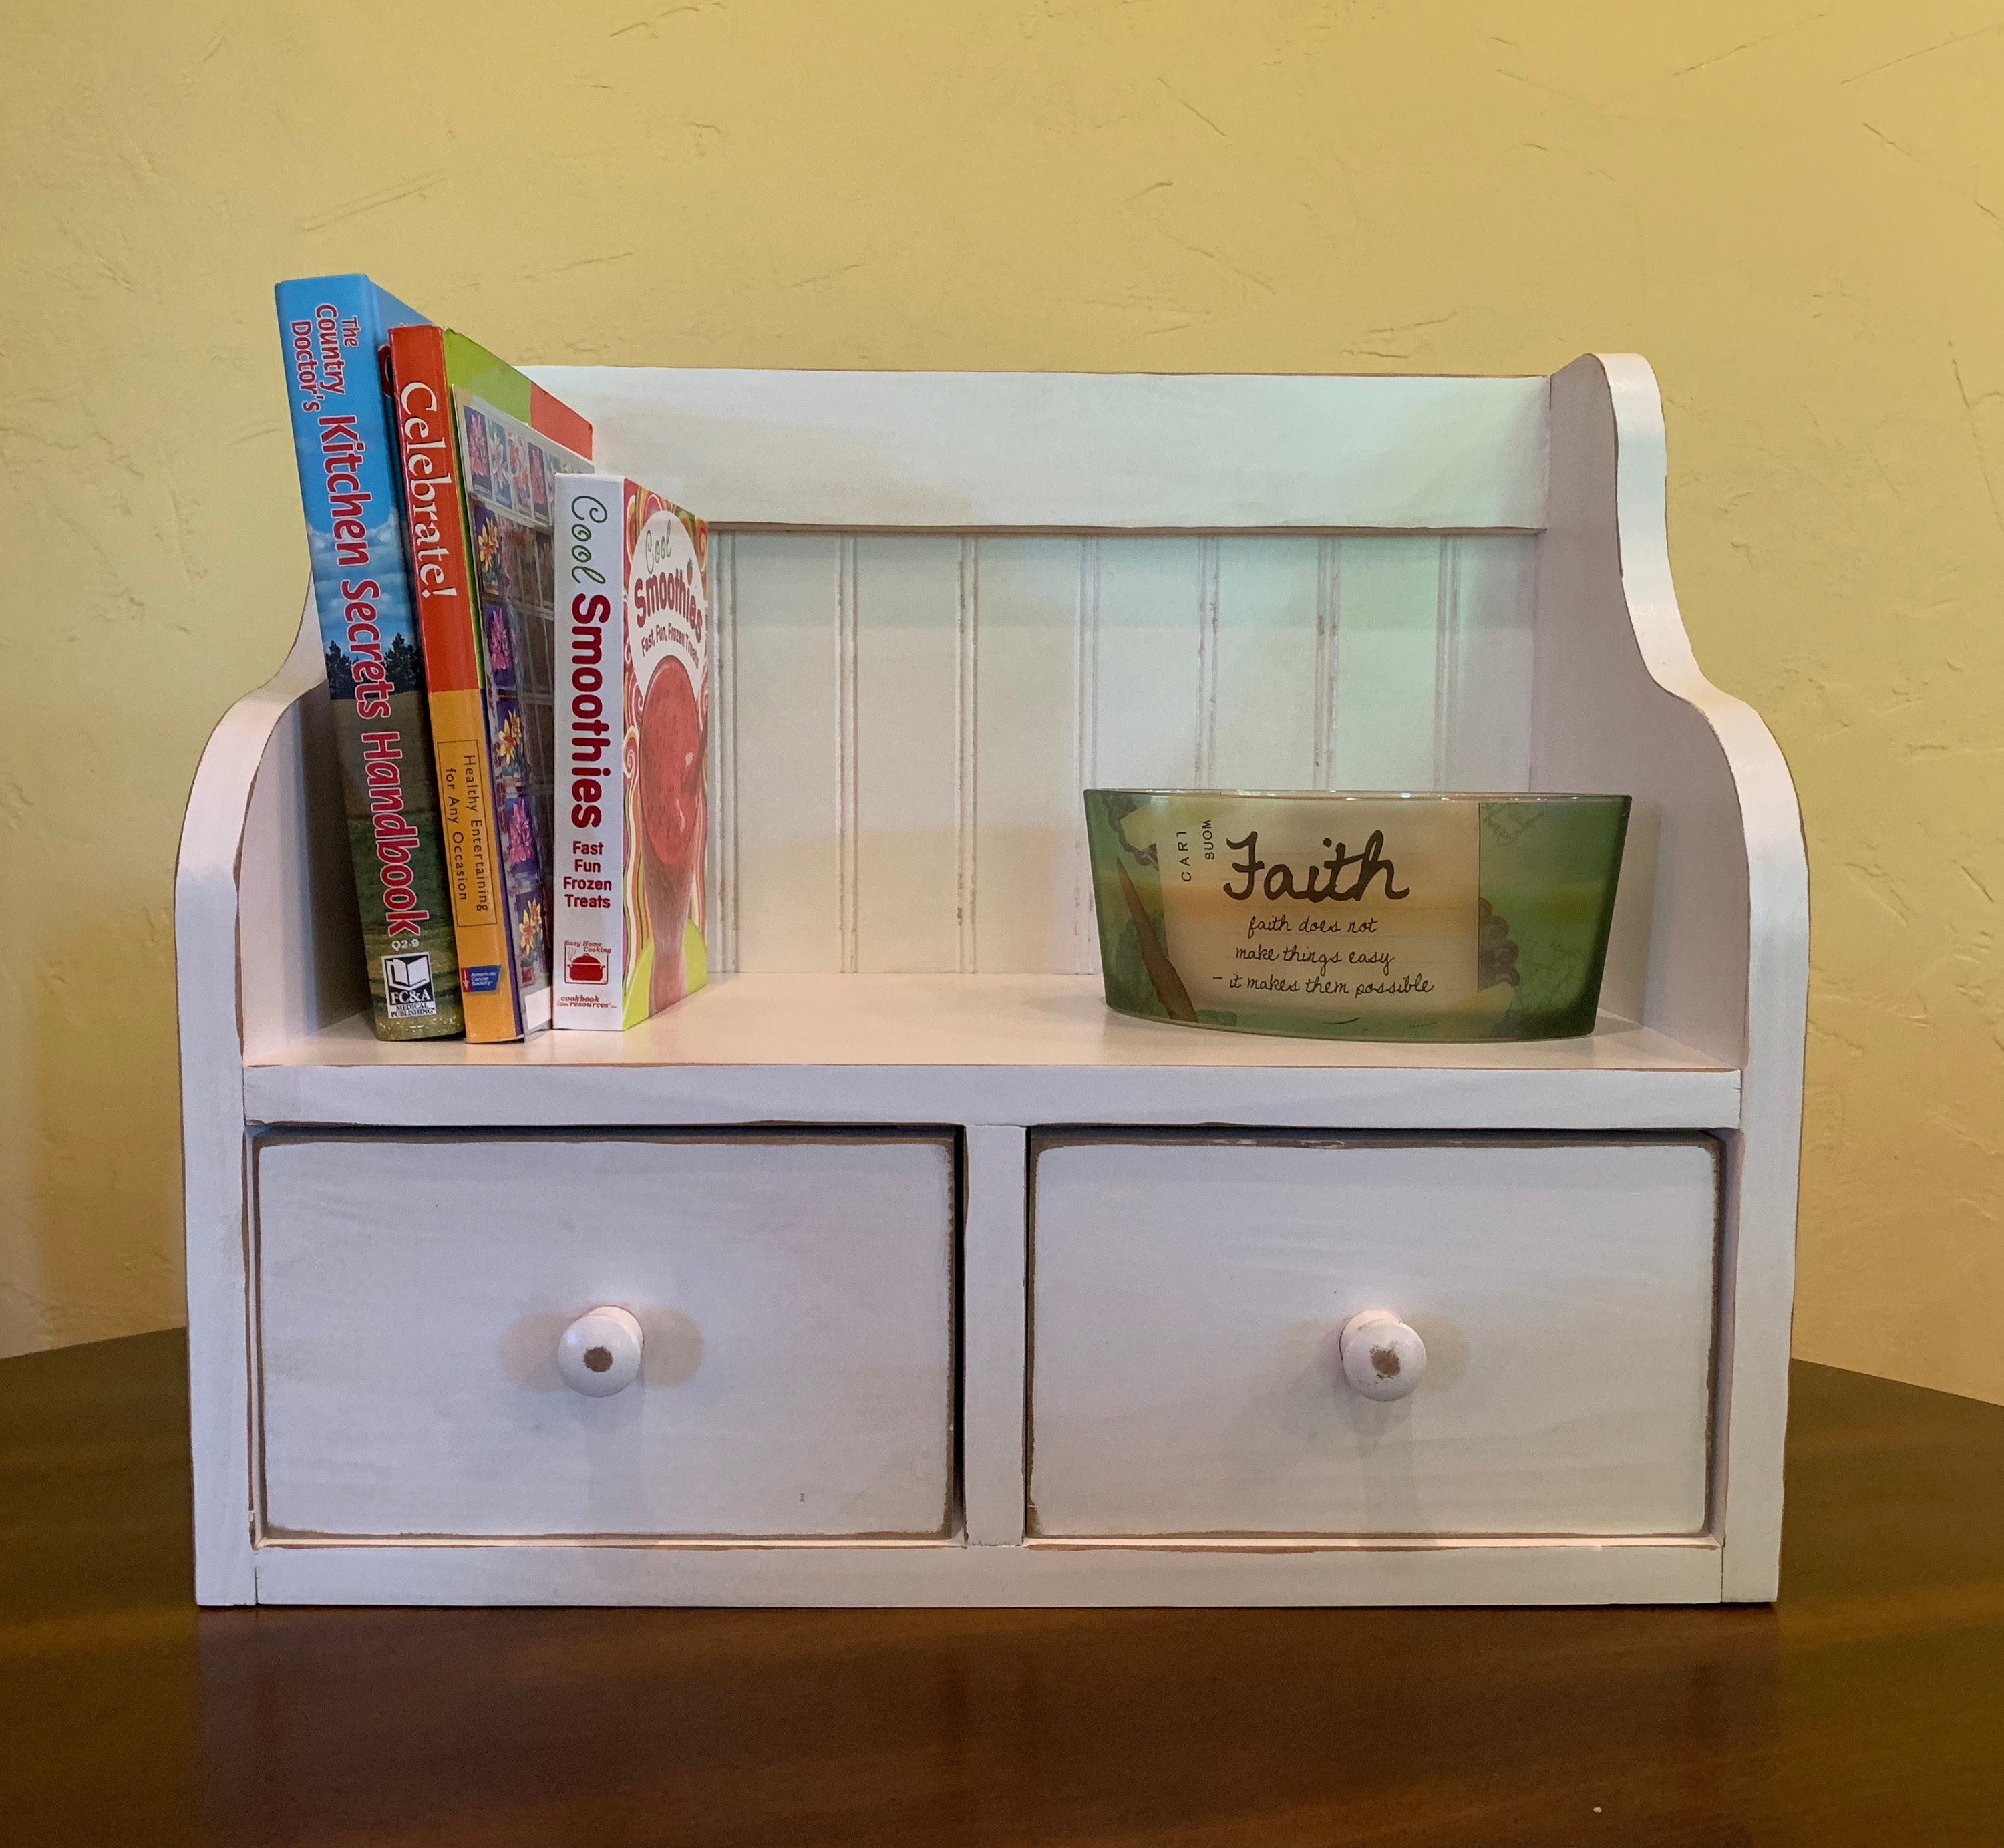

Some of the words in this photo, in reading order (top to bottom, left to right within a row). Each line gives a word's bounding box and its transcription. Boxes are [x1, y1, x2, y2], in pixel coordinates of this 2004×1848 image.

[315, 303, 346, 395] Country
[340, 315, 361, 347] The
[290, 319, 321, 412] Doctor's
[318, 415, 373, 567] Kitchen
[401, 381, 458, 599] Celebrate!
[571, 495, 608, 584] Cool
[645, 519, 672, 574] Cool
[634, 559, 703, 643] Smoothies
[340, 579, 395, 720] Secrets
[571, 593, 611, 828] Smoothies
[445, 768, 457, 790] for
[464, 755, 480, 812] Healthy
[361, 732, 430, 937] Handbook
[448, 796, 460, 824] Any
[452, 832, 468, 900] Occasion
[470, 820, 488, 911] Entertaining
[572, 840, 604, 855] Fast
[574, 859, 601, 873] Fun
[1222, 830, 1410, 903] Faith
[563, 876, 612, 891] Frozen
[564, 894, 611, 908] Treats
[1248, 914, 1291, 938] faith
[1298, 915, 1341, 933] does
[1347, 917, 1379, 933] not
[1229, 973, 1243, 989] it
[1246, 974, 1300, 991] makes
[1305, 977, 1349, 994] them
[1355, 973, 1435, 998] possible
[1236, 944, 1279, 961] make
[1283, 945, 1342, 976] things
[1349, 951, 1395, 976] easy
[390, 989, 432, 1005] FC&A
[395, 1002, 430, 1012] MEDICAL
